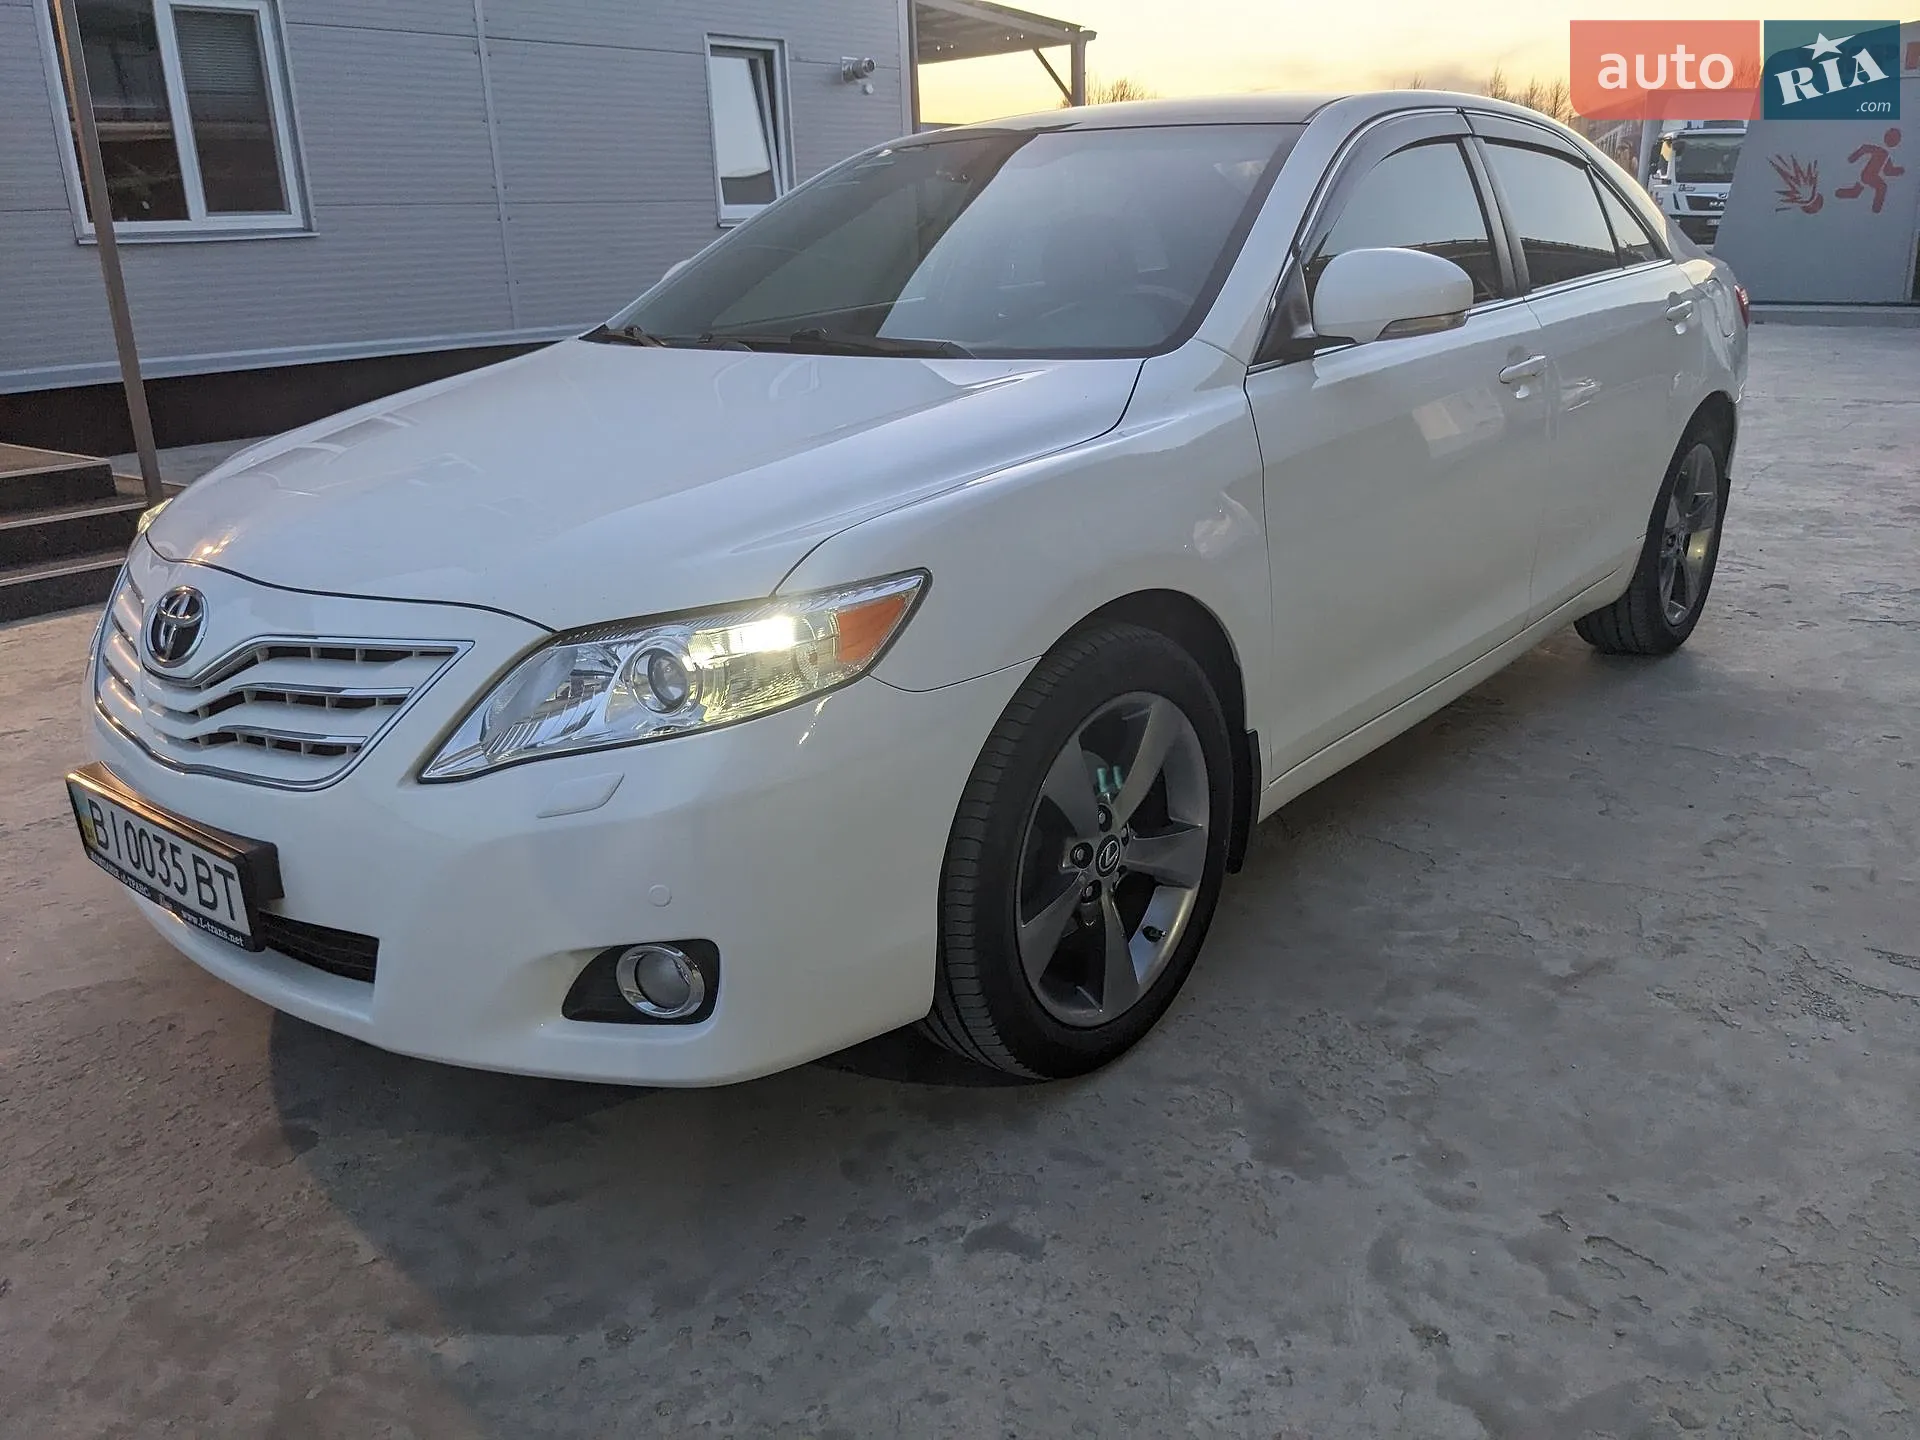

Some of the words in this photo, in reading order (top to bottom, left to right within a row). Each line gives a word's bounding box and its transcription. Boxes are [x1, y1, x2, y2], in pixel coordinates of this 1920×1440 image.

[88, 798, 122, 860] BI
[124, 819, 188, 897] 0035
[192, 853, 236, 921] BT
